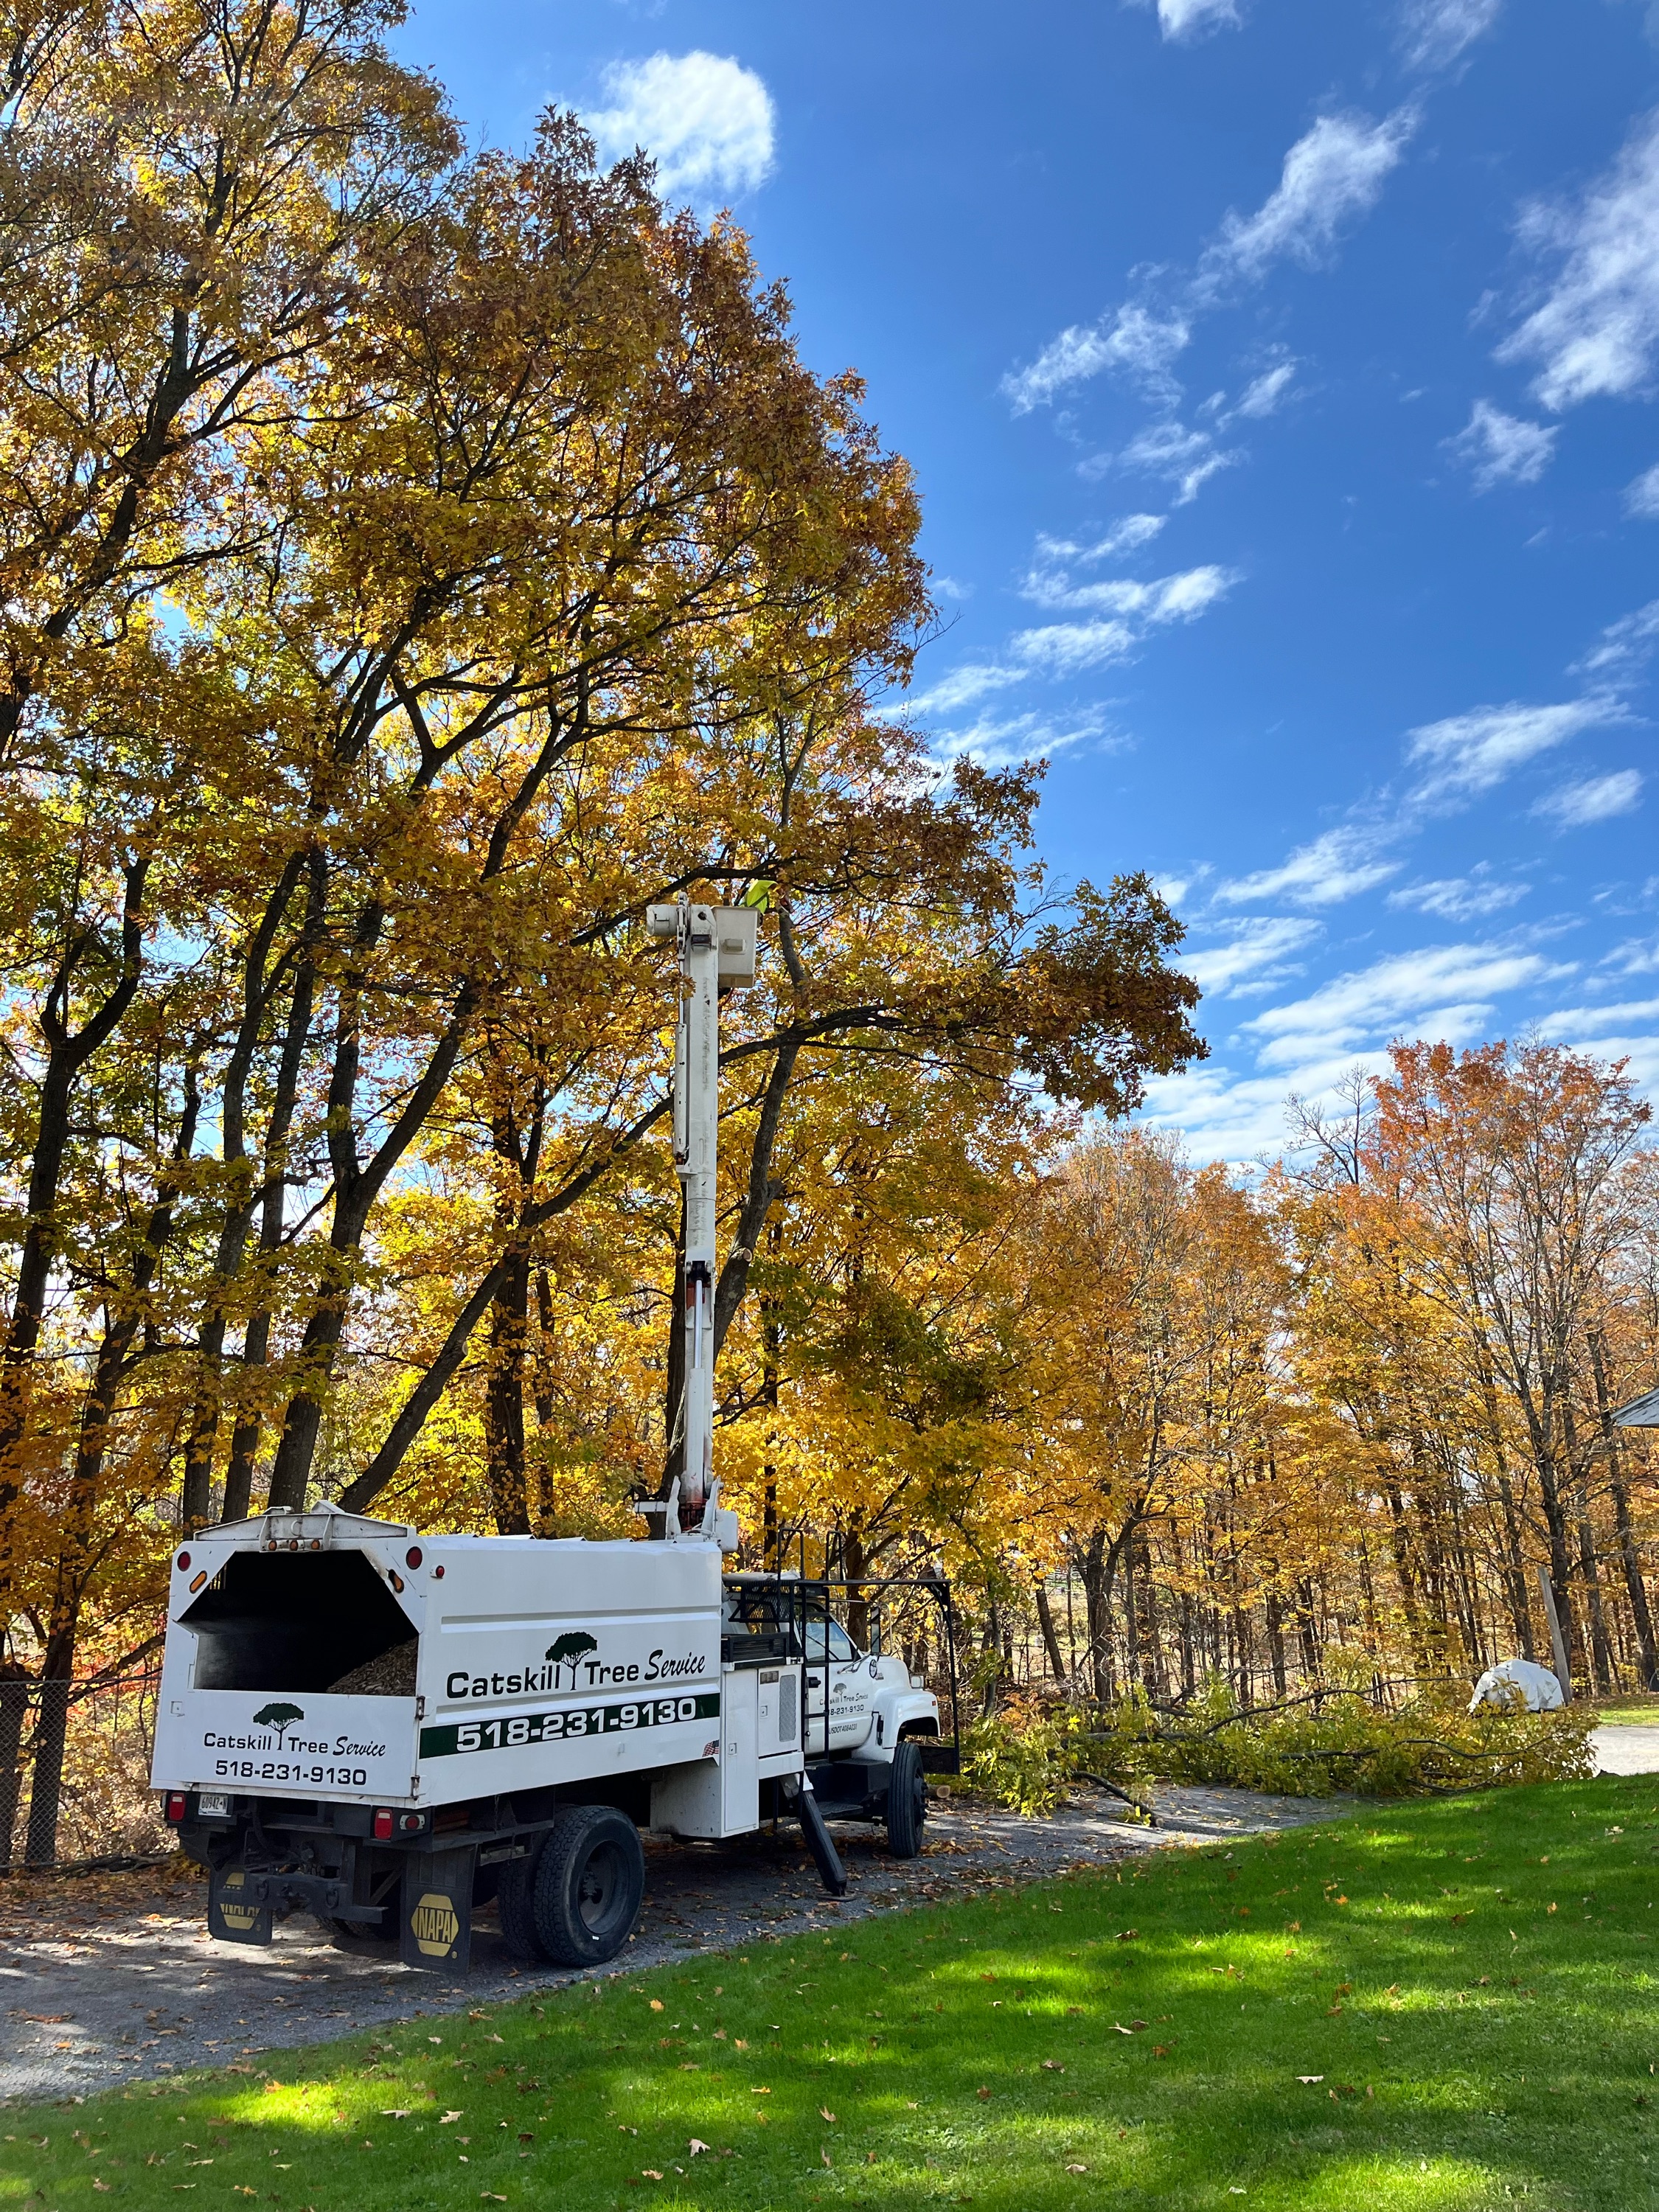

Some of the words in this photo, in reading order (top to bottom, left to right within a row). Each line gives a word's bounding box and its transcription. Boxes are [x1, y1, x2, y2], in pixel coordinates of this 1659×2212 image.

[446, 1664, 560, 1699] Catskill
[584, 1660, 639, 1685] Tree
[644, 1649, 706, 1680] Service
[819, 1697, 840, 1705] Cskill
[456, 1697, 696, 1752] 518-231-9130
[204, 1733, 272, 1750] Catskill
[288, 1736, 328, 1753] Tree
[332, 1736, 386, 1757] Service
[215, 1759, 366, 1785] 518-231-9130
[418, 1907, 451, 1943] NAPA
